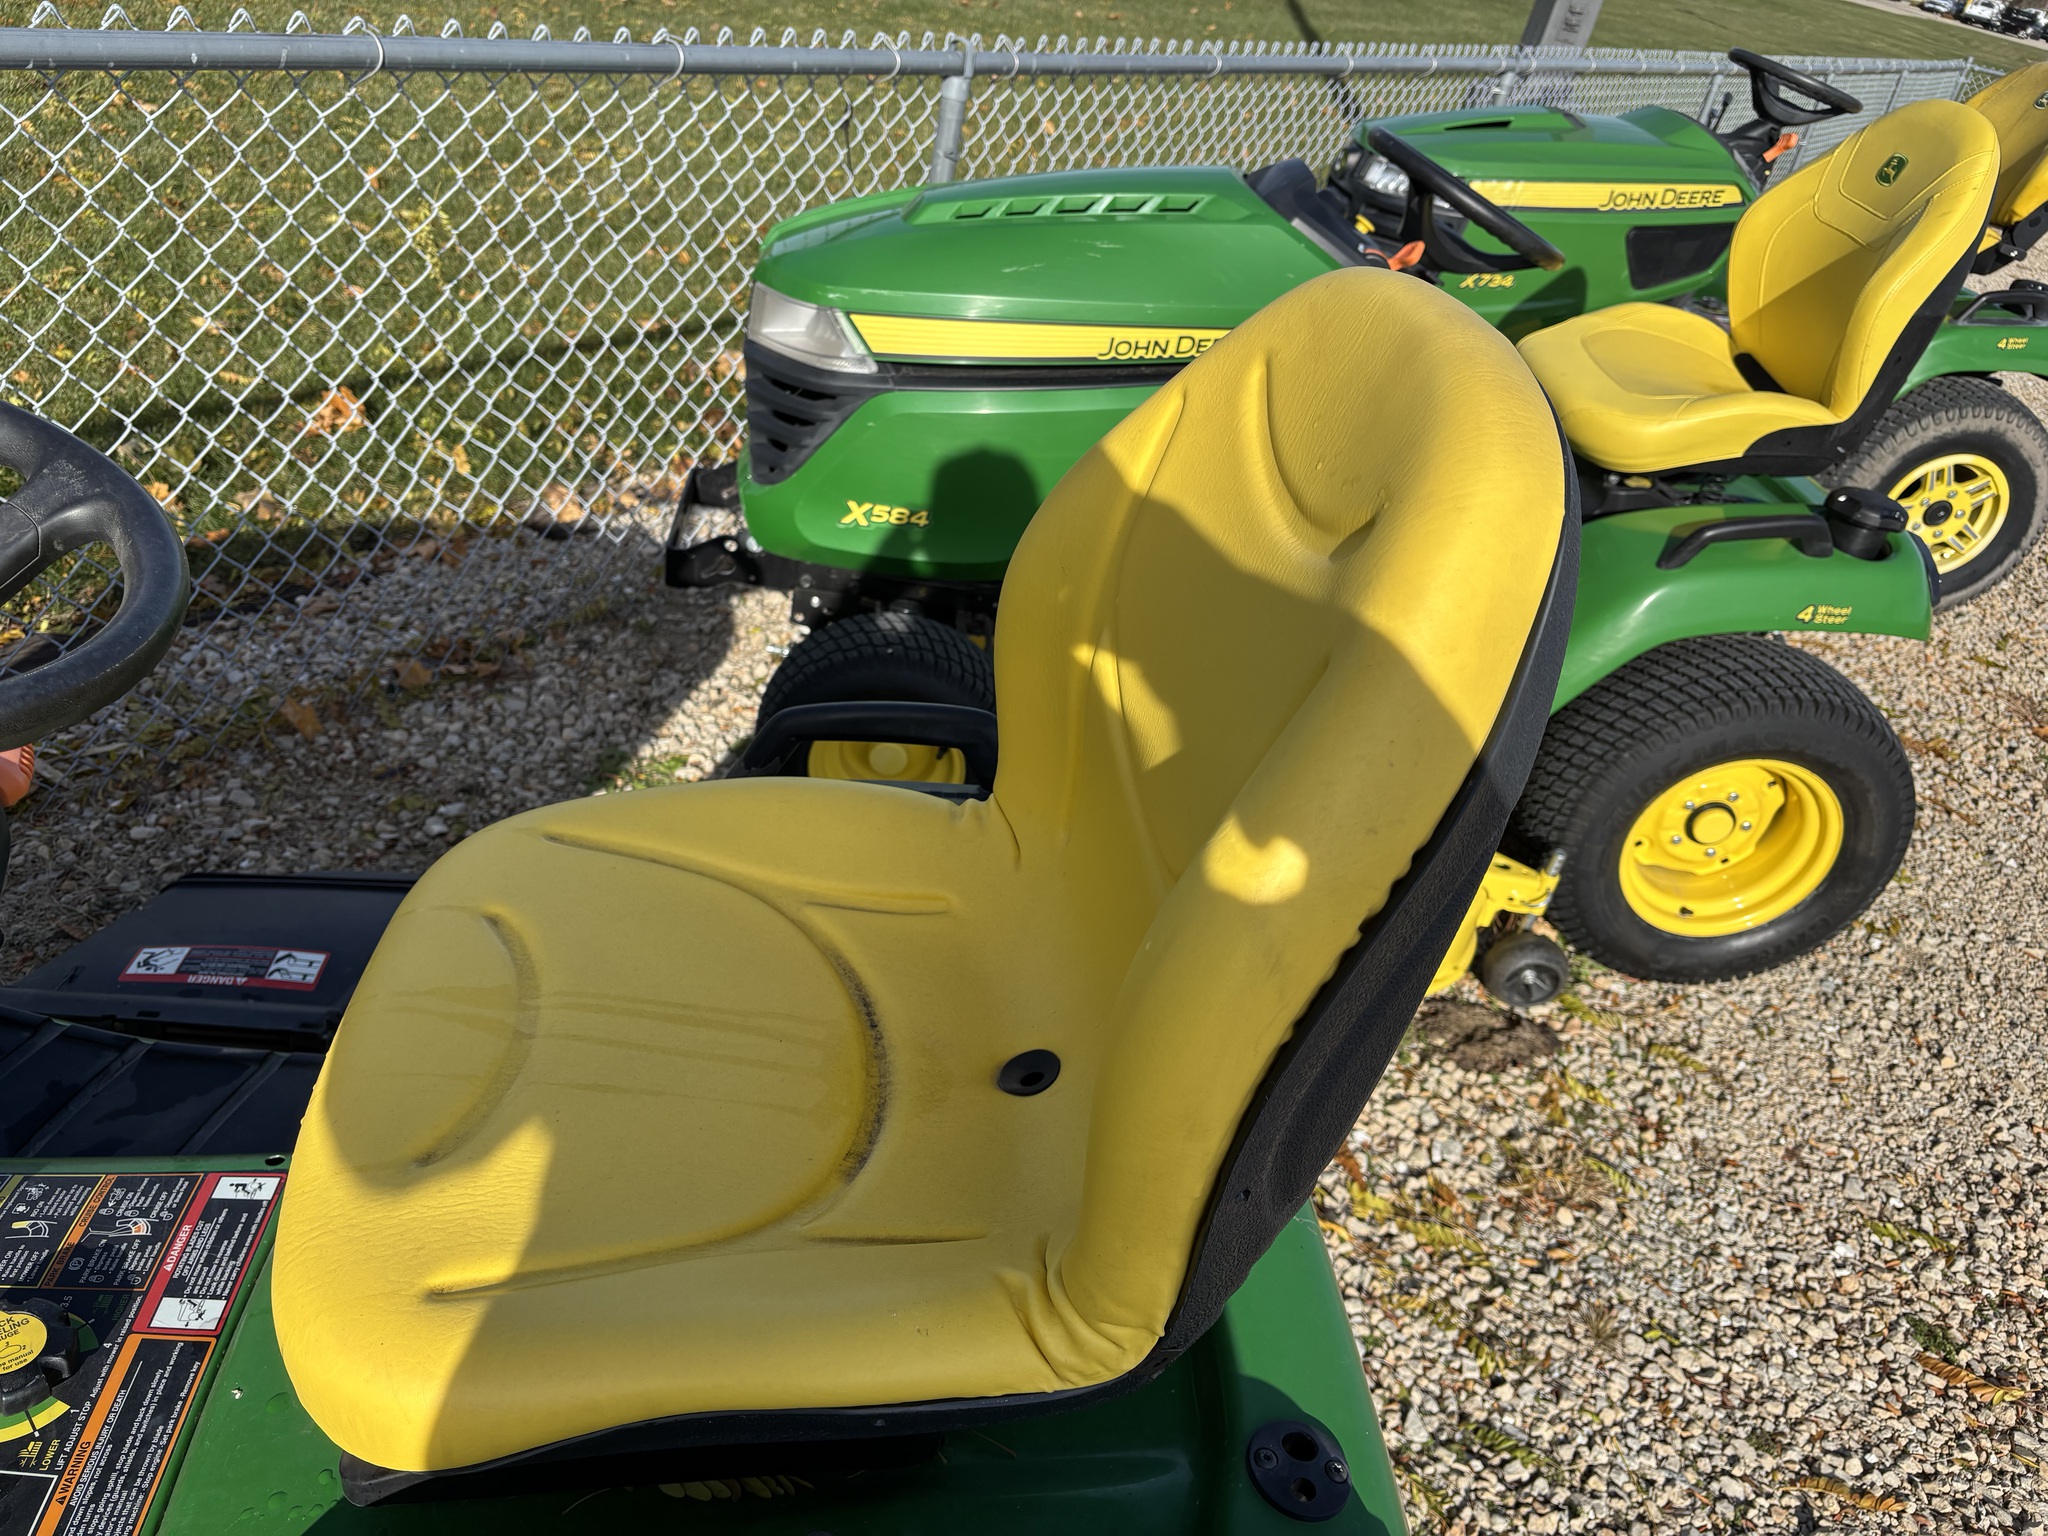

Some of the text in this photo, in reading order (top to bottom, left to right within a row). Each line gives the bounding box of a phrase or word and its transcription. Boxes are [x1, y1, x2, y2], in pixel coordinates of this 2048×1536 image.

[1599, 188, 1725, 208] JOHN DEERE
[1458, 272, 1516, 289] X734
[1098, 336, 1222, 357] JOHN DE
[840, 500, 930, 527] X584
[1796, 604, 1852, 624] 4 Wheel
[1813, 614, 1848, 624] Steer
[187, 974, 235, 986] DANGER
[80, 1177, 112, 1226] CRUISE CONTROL
[168, 1224, 192, 1264] DANGER
[173, 1219, 204, 1278] ROTATING BLADES CUT
[182, 1222, 210, 1276] OFF ARMS AND LEGS
[44, 1242, 74, 1285] PARK BRAKE
[60, 1296, 72, 1308] 3.5
[0, 1328, 20, 1340] UGE
[2, 1364, 13, 1372] for
[14, 1358, 28, 1366] use
[8, 1350, 34, 1364] manual
[54, 1453, 68, 1470] LIFT
[63, 1421, 83, 1452] ADJUST
[78, 1400, 93, 1420] STOP
[89, 1378, 104, 1397] Adjust
[100, 1364, 109, 1376] with
[106, 1343, 119, 1363] mower
[119, 1318, 131, 1335] raised
[151, 1449, 163, 1467] engine
[165, 1419, 175, 1433] park
[171, 1401, 182, 1417] brake
[191, 1361, 199, 1371] key
[69, 1389, 126, 1505] AVOID SERIOUS INJURY OR DEATH
[87, 1514, 101, 1533] stops
[96, 1493, 109, 1512] going
[105, 1471, 119, 1490] uphill,
[115, 1454, 126, 1469] stop
[121, 1436, 133, 1453] blade
[129, 1422, 139, 1434] and
[136, 1407, 146, 1421] back
[142, 1389, 153, 1405] down
[150, 1369, 163, 1387] slowly
[98, 1503, 114, 1529] devices
[110, 1473, 126, 1501] (guards,
[122, 1447, 137, 1472] shields,
[133, 1433, 143, 1445] and
[139, 1403, 156, 1432] switches)
[156, 1379, 167, 1394] place
[163, 1366, 171, 1377] and
[169, 1342, 183, 1364] working
[39, 1439, 61, 1470] LOWER
[59, 1441, 90, 1493] WARNING
[122, 1501, 132, 1515] that
[128, 1488, 138, 1499] can
[134, 1477, 142, 1485] be
[138, 1453, 151, 1476] thrown
[152, 1425, 163, 1442] blade
[72, 1506, 84, 1525] down
[81, 1479, 97, 1504] slopes,
[93, 1467, 101, 1478] not
[99, 1444, 112, 1465] across
[83, 1503, 95, 1522] turns
[113, 1490, 127, 1515] manual
